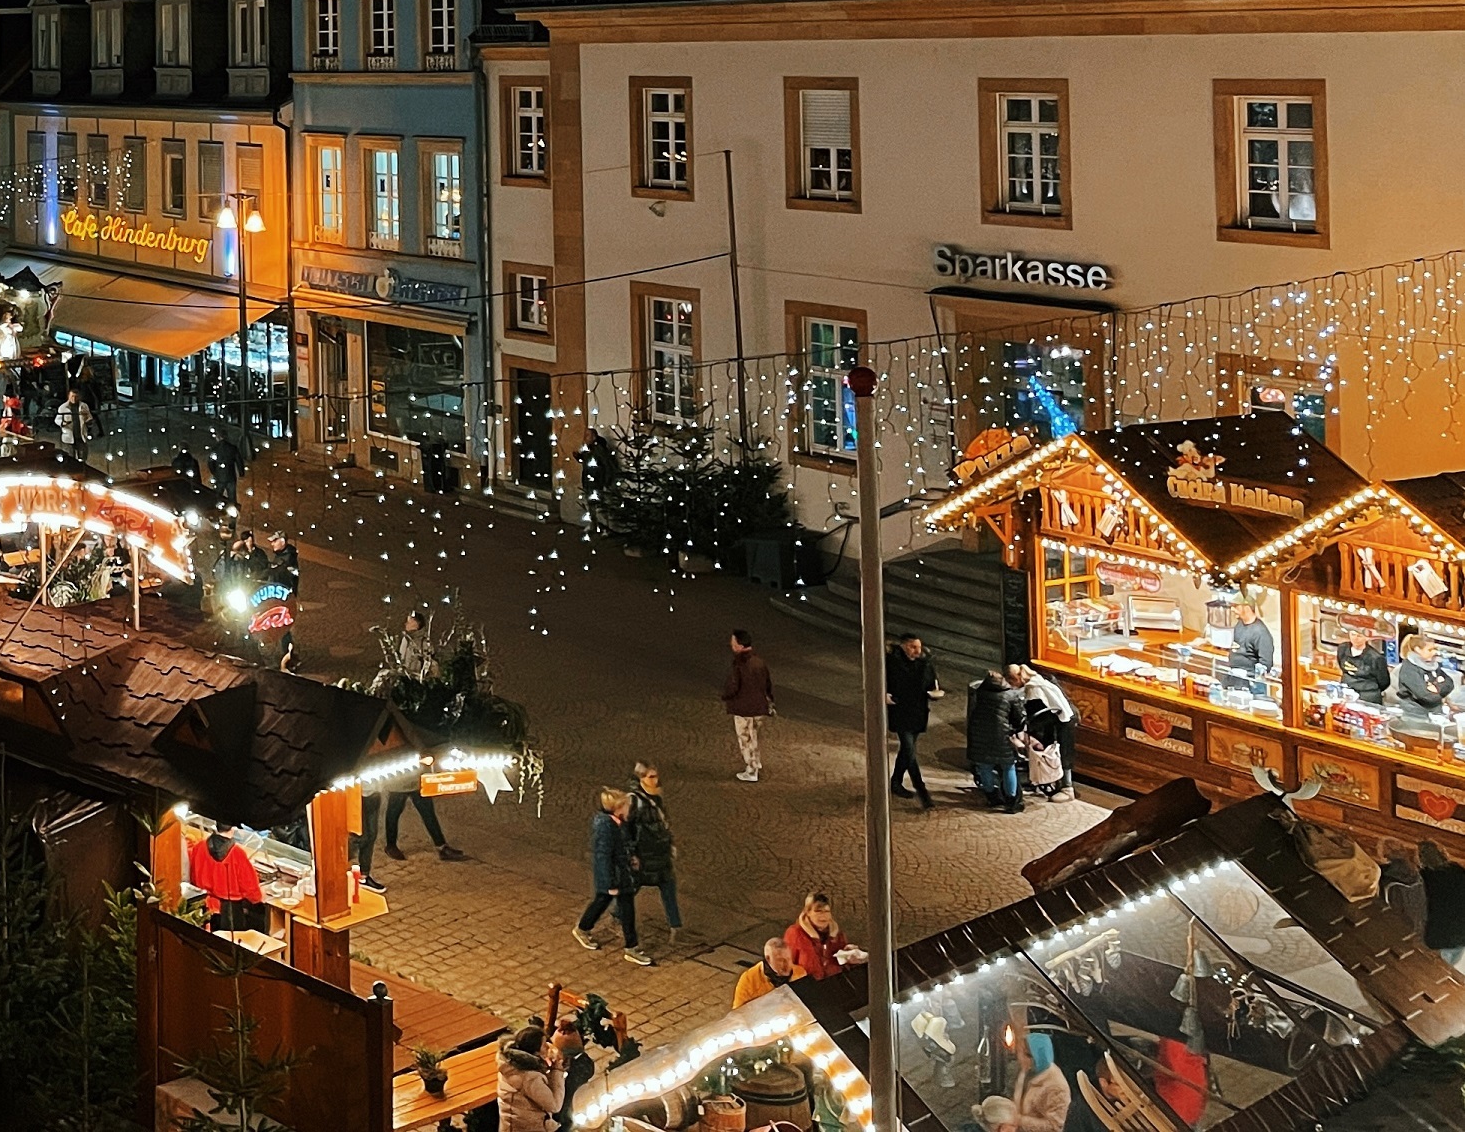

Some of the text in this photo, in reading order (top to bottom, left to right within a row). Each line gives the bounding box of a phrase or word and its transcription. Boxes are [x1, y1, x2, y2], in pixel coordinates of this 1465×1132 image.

[100, 214, 211, 263] Hindenburg
[935, 245, 1109, 291] Sparkasse
[13, 484, 157, 539] WURST Koch
[1167, 476, 1304, 519] Cucina Italiana
[250, 585, 289, 607] WURST
[248, 606, 294, 633] Koch
